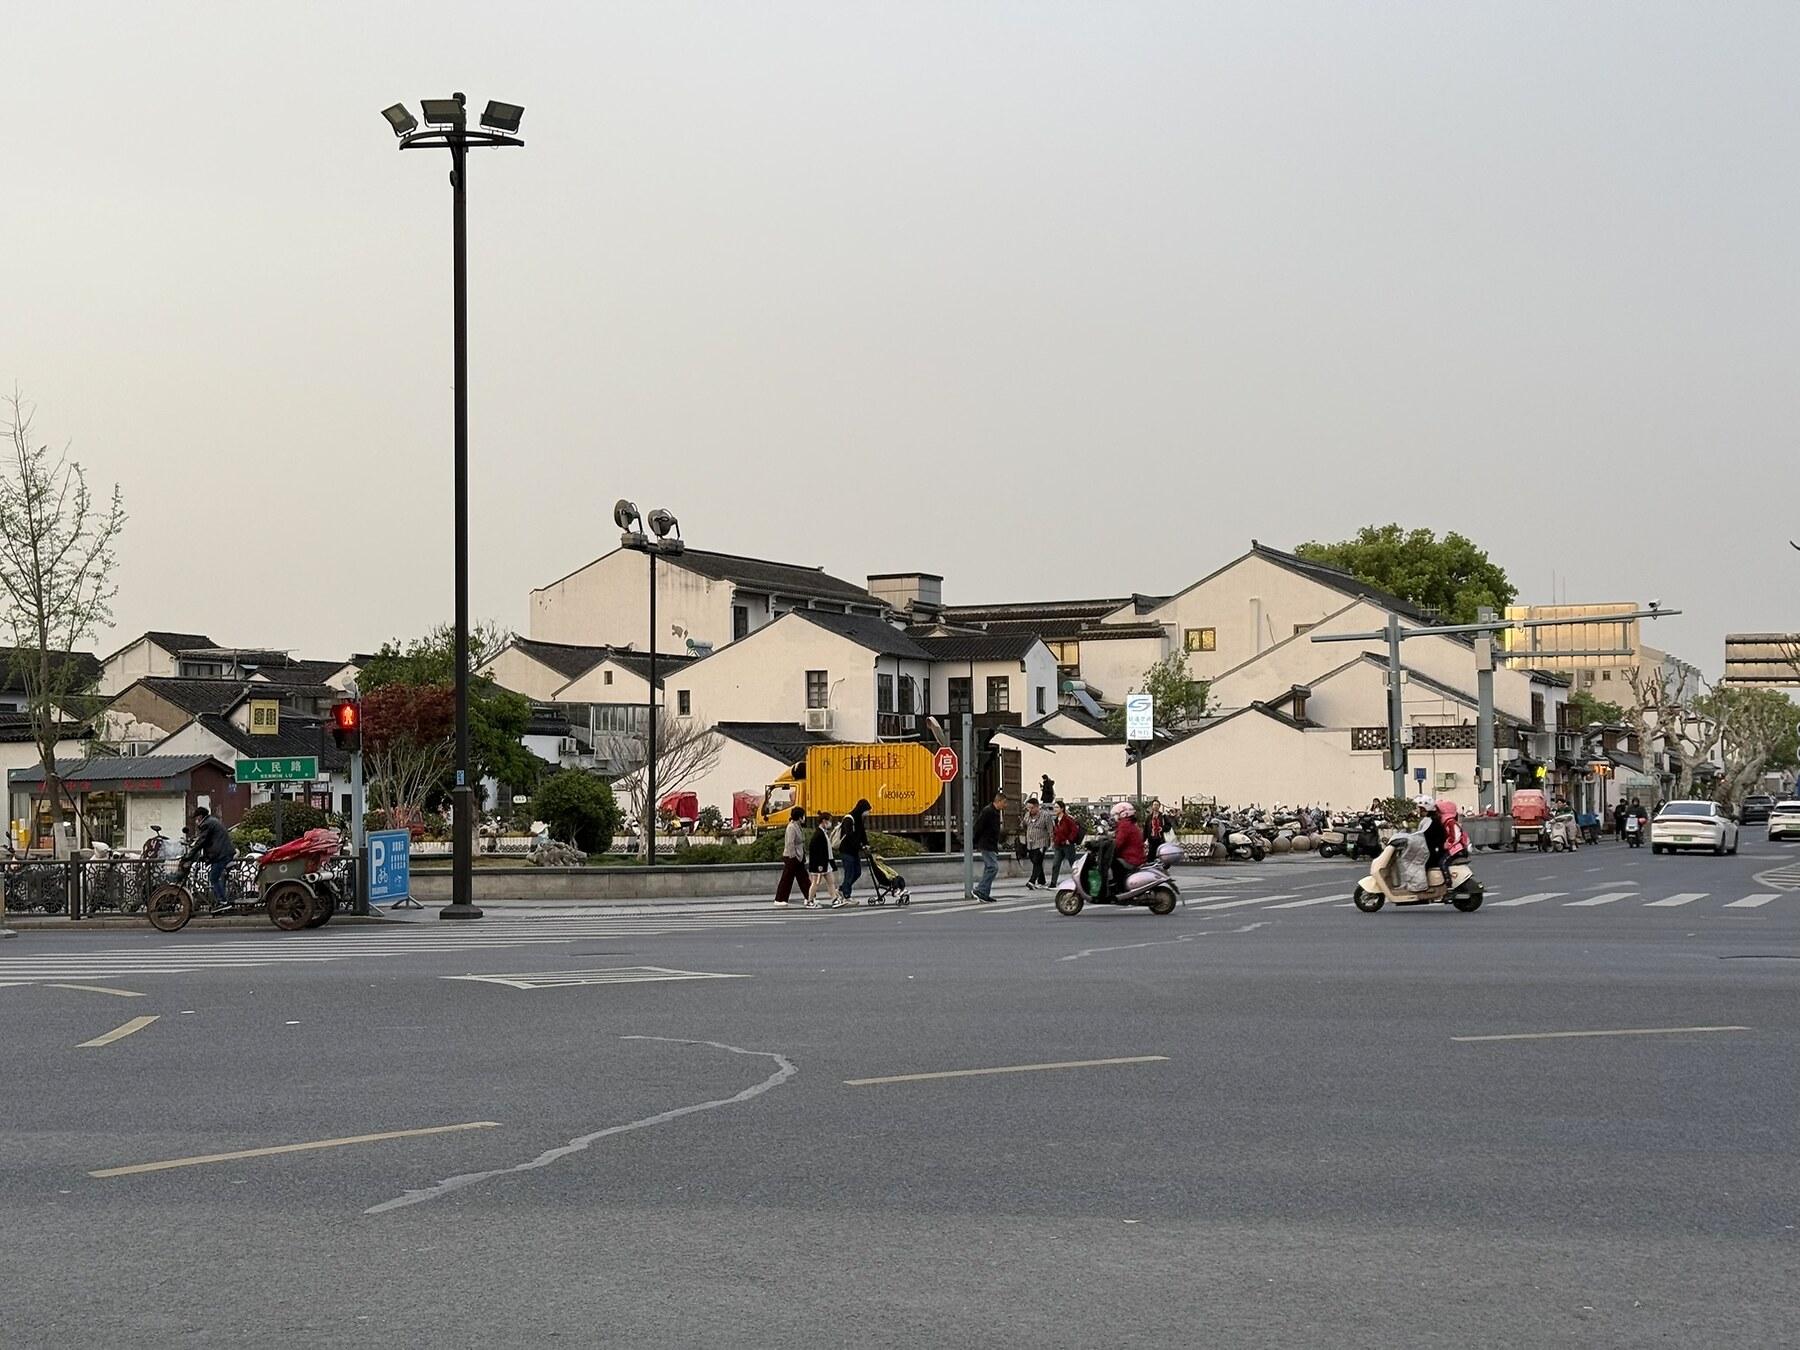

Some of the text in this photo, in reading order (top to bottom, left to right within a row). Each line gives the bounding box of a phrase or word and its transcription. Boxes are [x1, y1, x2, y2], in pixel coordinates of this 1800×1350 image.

[251, 761, 301, 773] 人民路
[938, 753, 954, 776] 停
[372, 840, 386, 885] P
